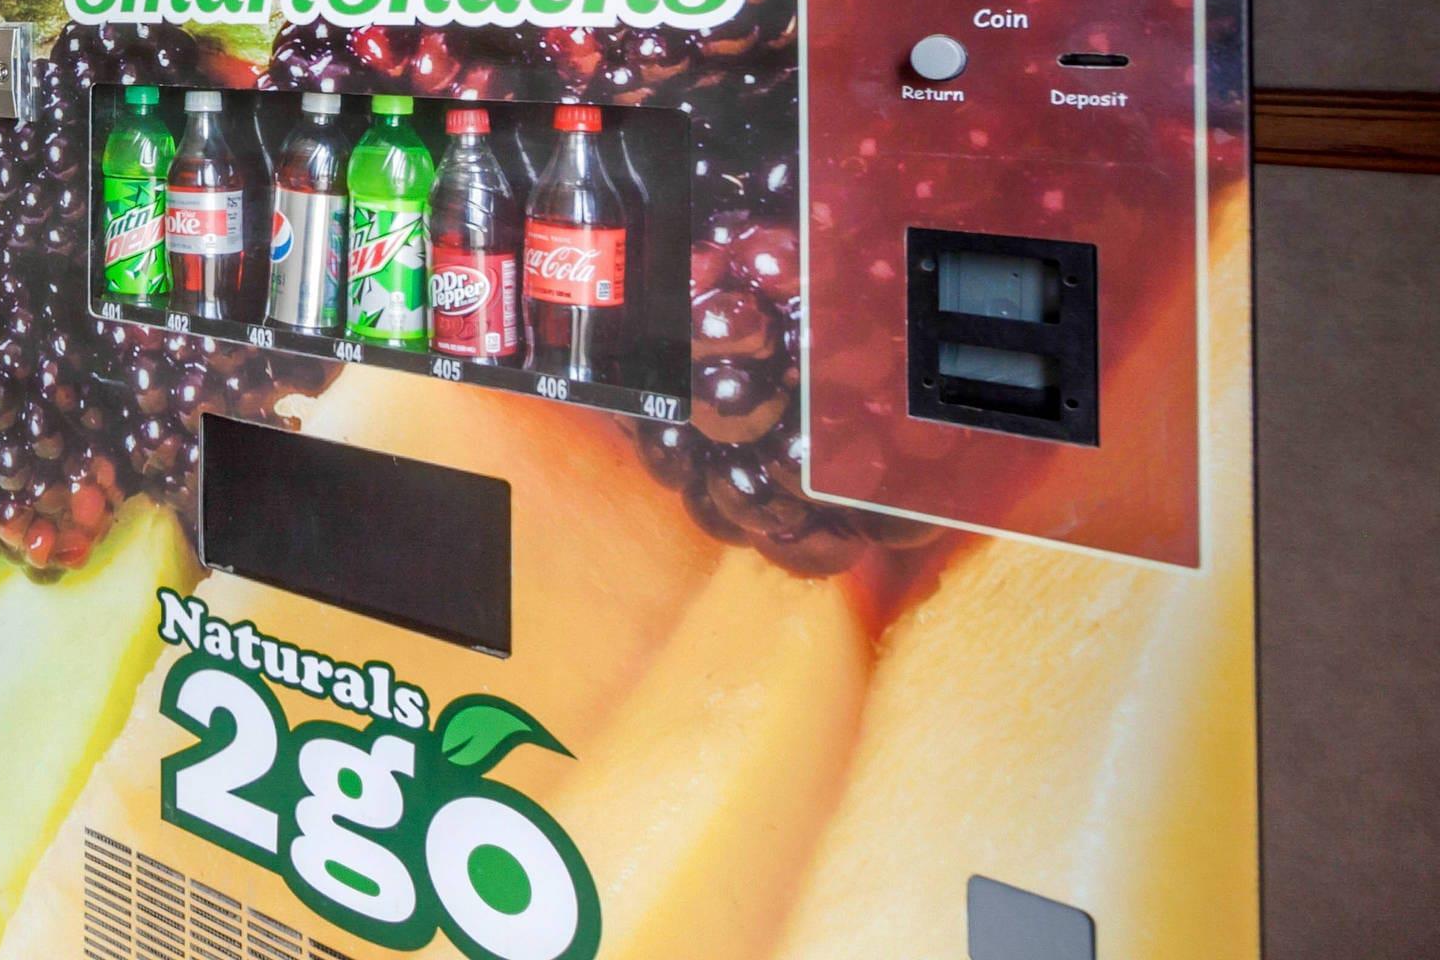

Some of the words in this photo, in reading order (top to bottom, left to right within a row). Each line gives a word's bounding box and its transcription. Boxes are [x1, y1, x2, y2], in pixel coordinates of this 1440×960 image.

[973, 8, 1029, 29] Coin
[902, 85, 964, 103] Return
[1050, 88, 1128, 110] Deposit
[168, 210, 201, 235] oke
[432, 274, 485, 310] Pepper
[443, 271, 468, 291] Dr
[102, 302, 122, 319] 401
[167, 313, 189, 331] 402
[250, 327, 273, 347] 403
[335, 341, 361, 362] 404
[433, 358, 460, 380] 405
[536, 375, 568, 400] 406
[643, 394, 678, 420] 407
[160, 591, 426, 728] Naturals
[175, 668, 579, 960] 2go
